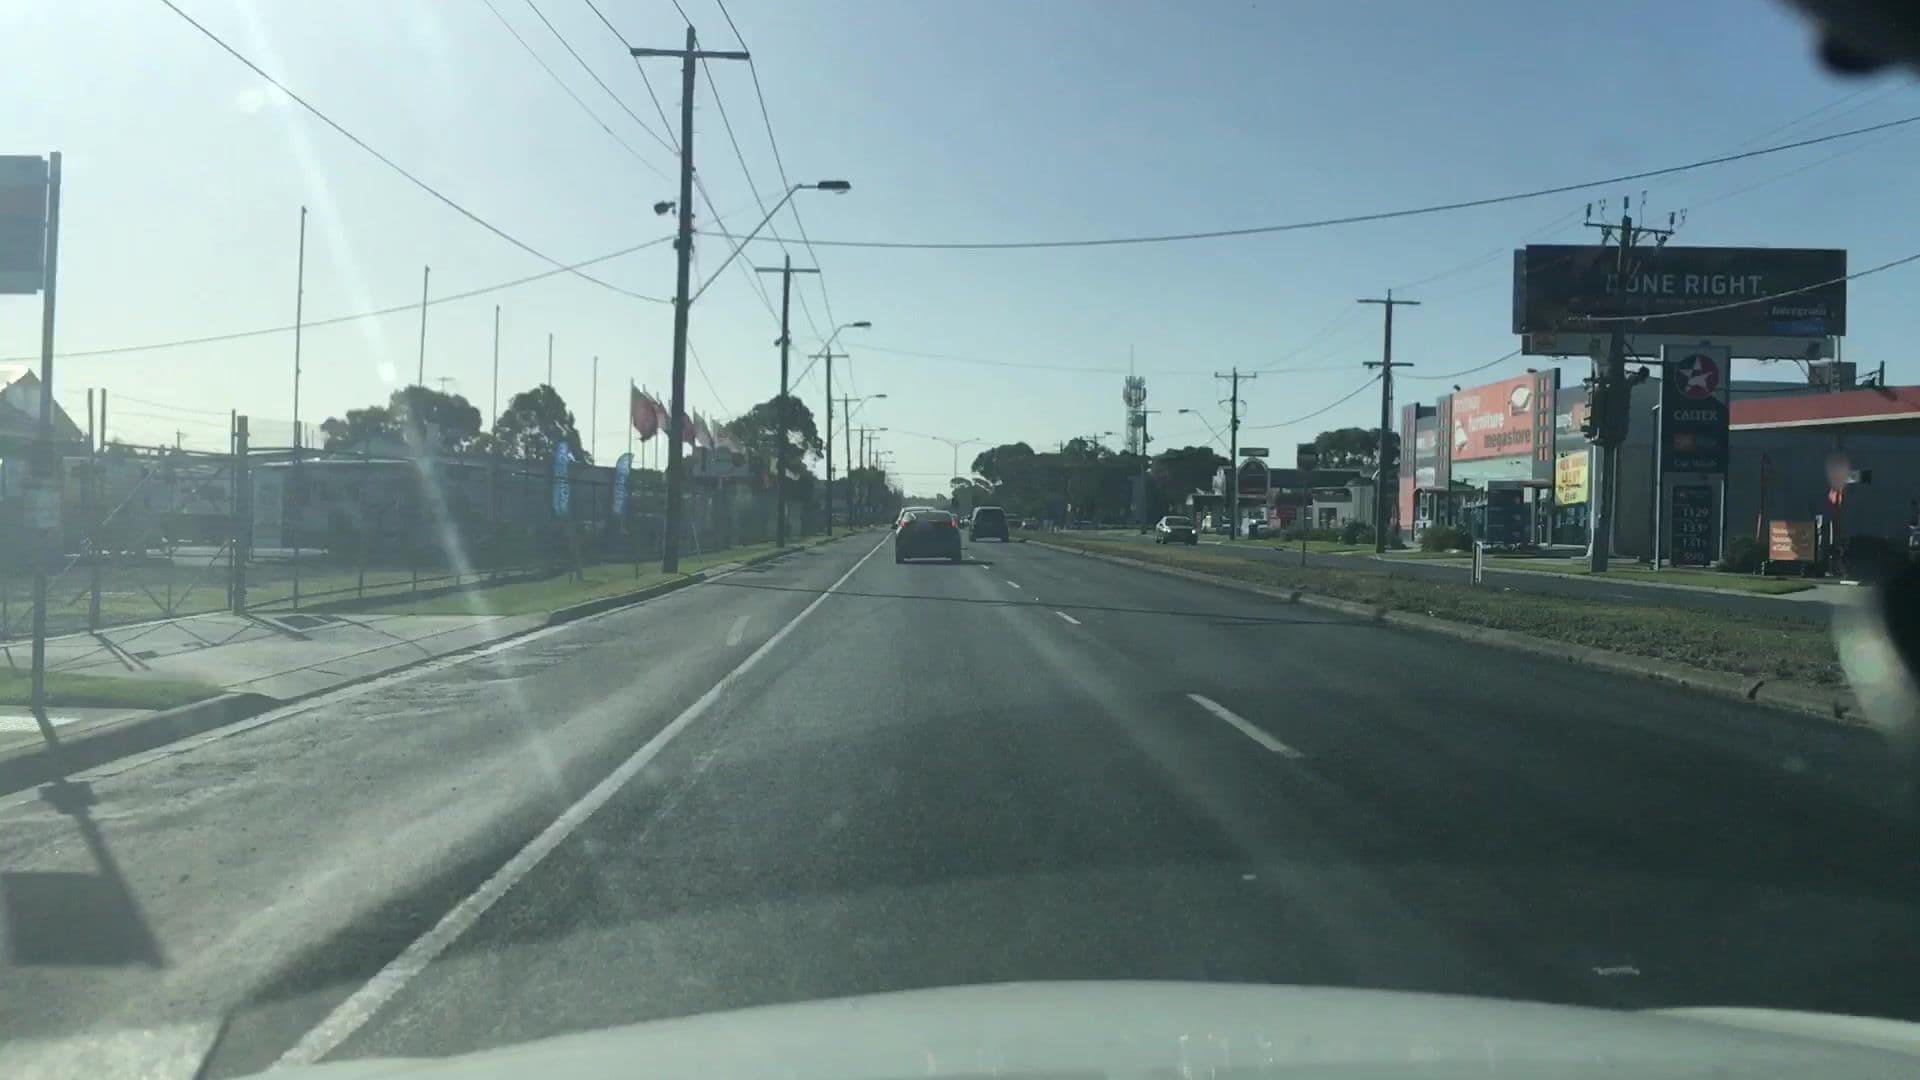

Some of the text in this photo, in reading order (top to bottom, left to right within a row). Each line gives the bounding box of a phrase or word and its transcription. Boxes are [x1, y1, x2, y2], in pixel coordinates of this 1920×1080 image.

[1685, 274, 1767, 296] RIGHT.
[1673, 409, 1719, 422] CALTEX
[1484, 428, 1531, 452] megastore
